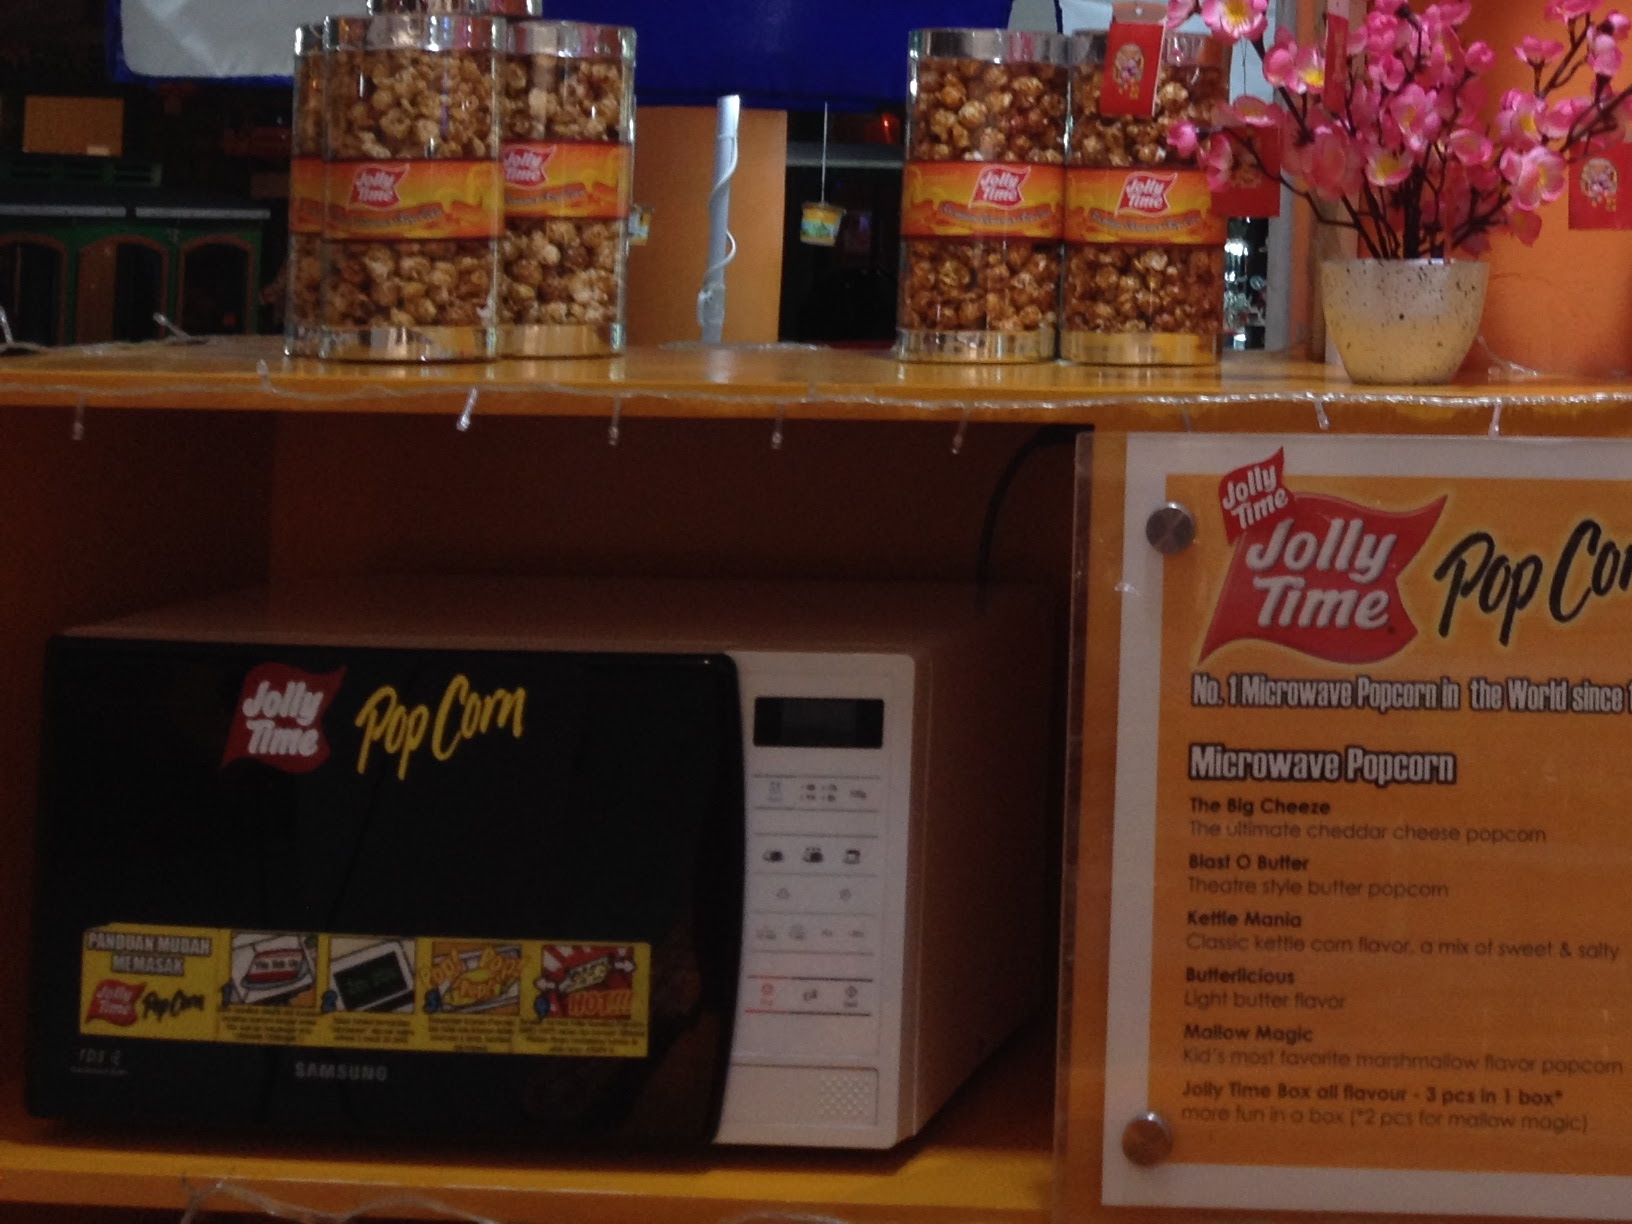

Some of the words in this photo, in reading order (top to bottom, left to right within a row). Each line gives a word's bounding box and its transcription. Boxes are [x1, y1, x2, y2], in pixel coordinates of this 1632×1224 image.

[1221, 464, 1277, 509] Jolly
[1230, 486, 1289, 530] Time
[1245, 518, 1398, 584] Jolly
[1252, 575, 1391, 631] Time
[242, 680, 325, 727] Jolly
[1191, 672, 1225, 707] No.
[1240, 674, 1354, 710] Microwave
[1356, 677, 1439, 715] Popcorn
[1440, 678, 1461, 711] in
[1470, 680, 1503, 712] the
[1506, 680, 1568, 714] World
[1571, 680, 1624, 715] since
[245, 719, 320, 758] Time
[1188, 742, 1342, 782] Microwave
[1344, 744, 1458, 789] Popcorn
[1190, 797, 1221, 814] The
[1227, 797, 1254, 817] Big
[1260, 797, 1331, 816] Cheeze
[1190, 820, 1221, 837] The
[1226, 821, 1301, 839] ultimate
[1306, 822, 1386, 841] cheddar
[1392, 824, 1460, 842] cheese
[1466, 827, 1548, 846] popcorn
[1188, 853, 1231, 871] Blast
[1236, 853, 1252, 871] O
[1256, 855, 1310, 872] Butter
[1188, 876, 1259, 895] Theatre
[1261, 877, 1303, 897] style
[1307, 878, 1364, 897] butter
[1367, 880, 1449, 900] popcorn
[1186, 910, 1240, 927] Kettle
[1245, 910, 1303, 928] Mania
[1186, 933, 1249, 951] Classic
[1253, 933, 1306, 952] kettle
[1419, 940, 1434, 955] a
[1438, 939, 1470, 956] mix
[1474, 937, 1494, 957] of
[1499, 941, 1554, 959] sweet
[1558, 942, 1573, 959] &
[1578, 942, 1621, 963] salty
[1185, 966, 1296, 985] Butterlicious
[1183, 989, 1229, 1011] Light
[1233, 989, 1290, 1010] butter
[1293, 991, 1346, 1011] flavor
[1183, 1024, 1251, 1042] Mallow
[1254, 1025, 1314, 1046] Magic
[295, 1061, 388, 1082] SAMSUNG
[1182, 1047, 1227, 1066] Kid's
[1229, 1049, 1276, 1067] most
[1279, 1049, 1351, 1068] favorite
[1356, 1053, 1479, 1073] marshmallow
[1484, 1054, 1537, 1073] flavor
[1181, 1080, 1224, 1100] Jolly
[1228, 1081, 1272, 1099] Time
[1276, 1082, 1311, 1100] Box
[1315, 1083, 1339, 1101] all
[1342, 1084, 1408, 1103] flavour
[1425, 1086, 1438, 1103] 3
[1441, 1089, 1476, 1107] pcs
[1480, 1087, 1498, 1104] in
[1181, 1107, 1231, 1123] more
[1234, 1104, 1266, 1123] fun
[1268, 1106, 1286, 1124] in
[1289, 1109, 1305, 1124] a
[1308, 1106, 1345, 1125] box
[1379, 1110, 1413, 1128] pcs
[1418, 1110, 1443, 1127] for
